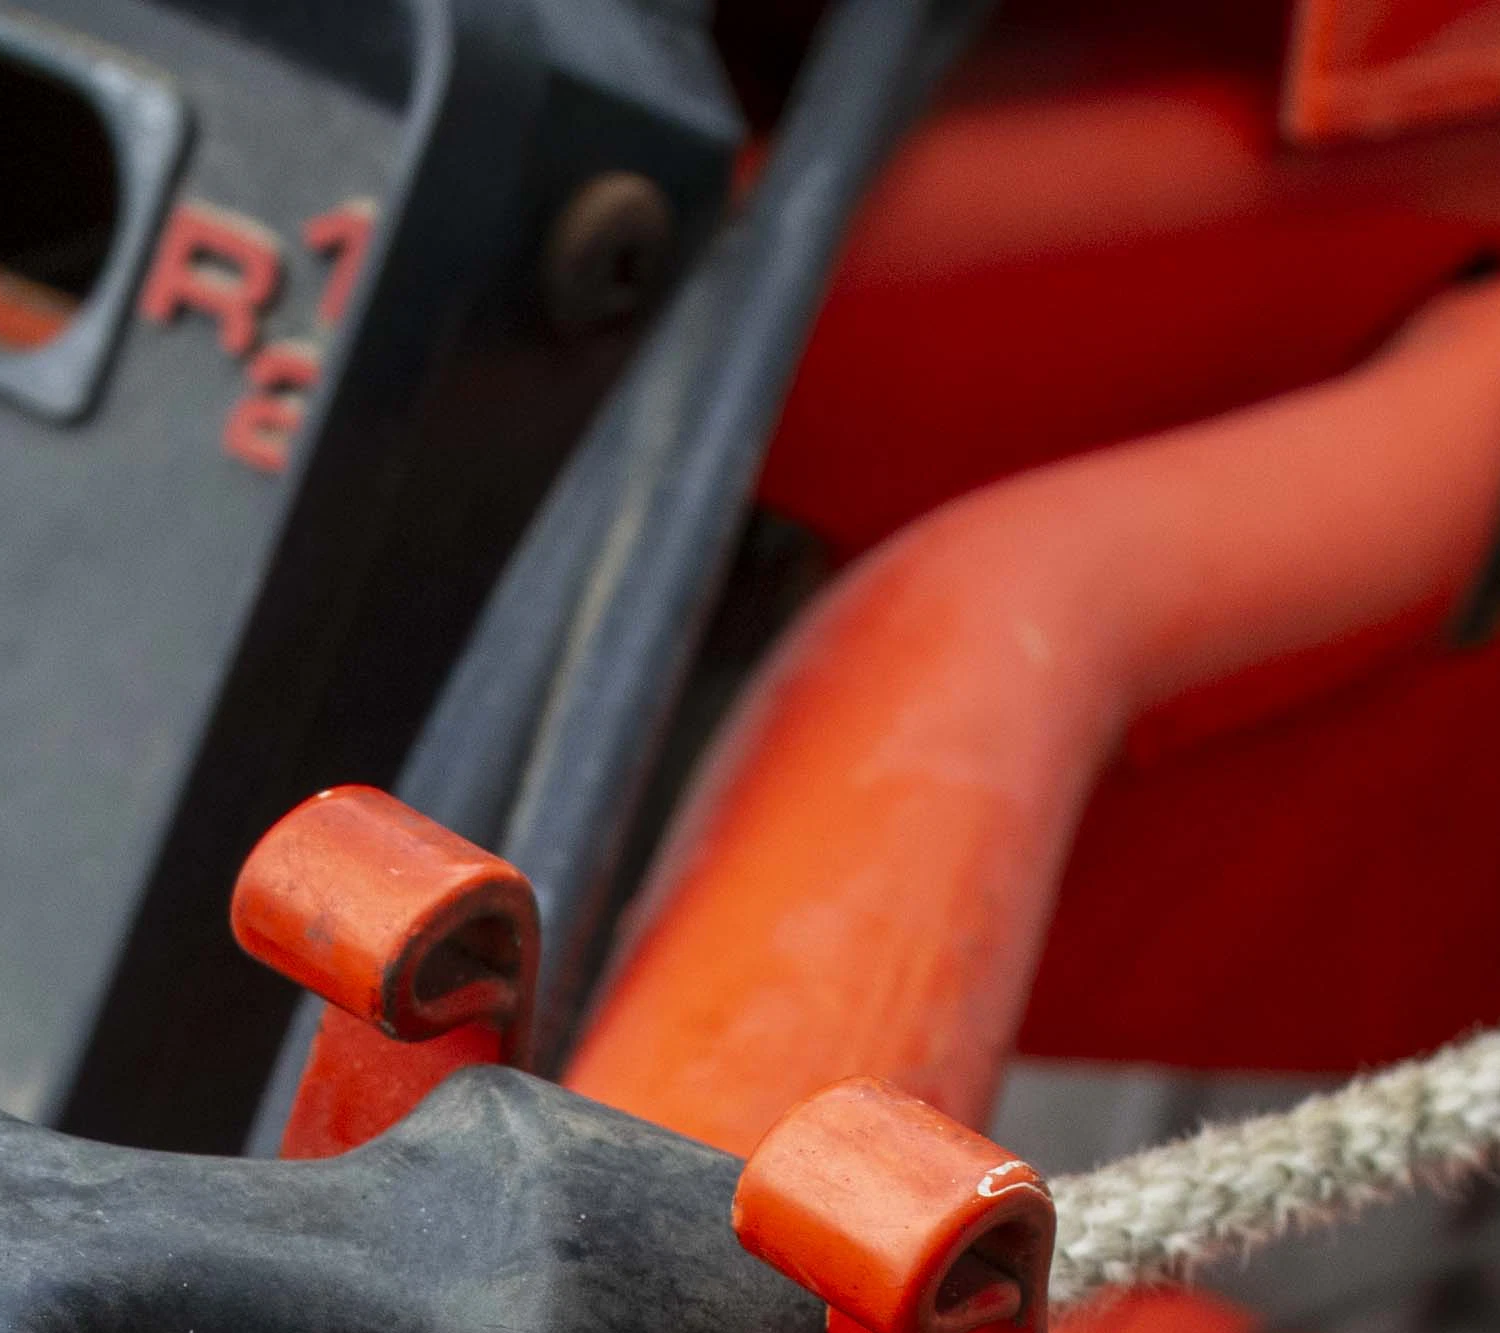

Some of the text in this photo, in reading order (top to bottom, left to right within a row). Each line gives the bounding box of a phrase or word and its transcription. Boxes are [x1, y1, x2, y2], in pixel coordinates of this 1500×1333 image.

[140, 197, 379, 357] R 1
[221, 337, 323, 474] 2
